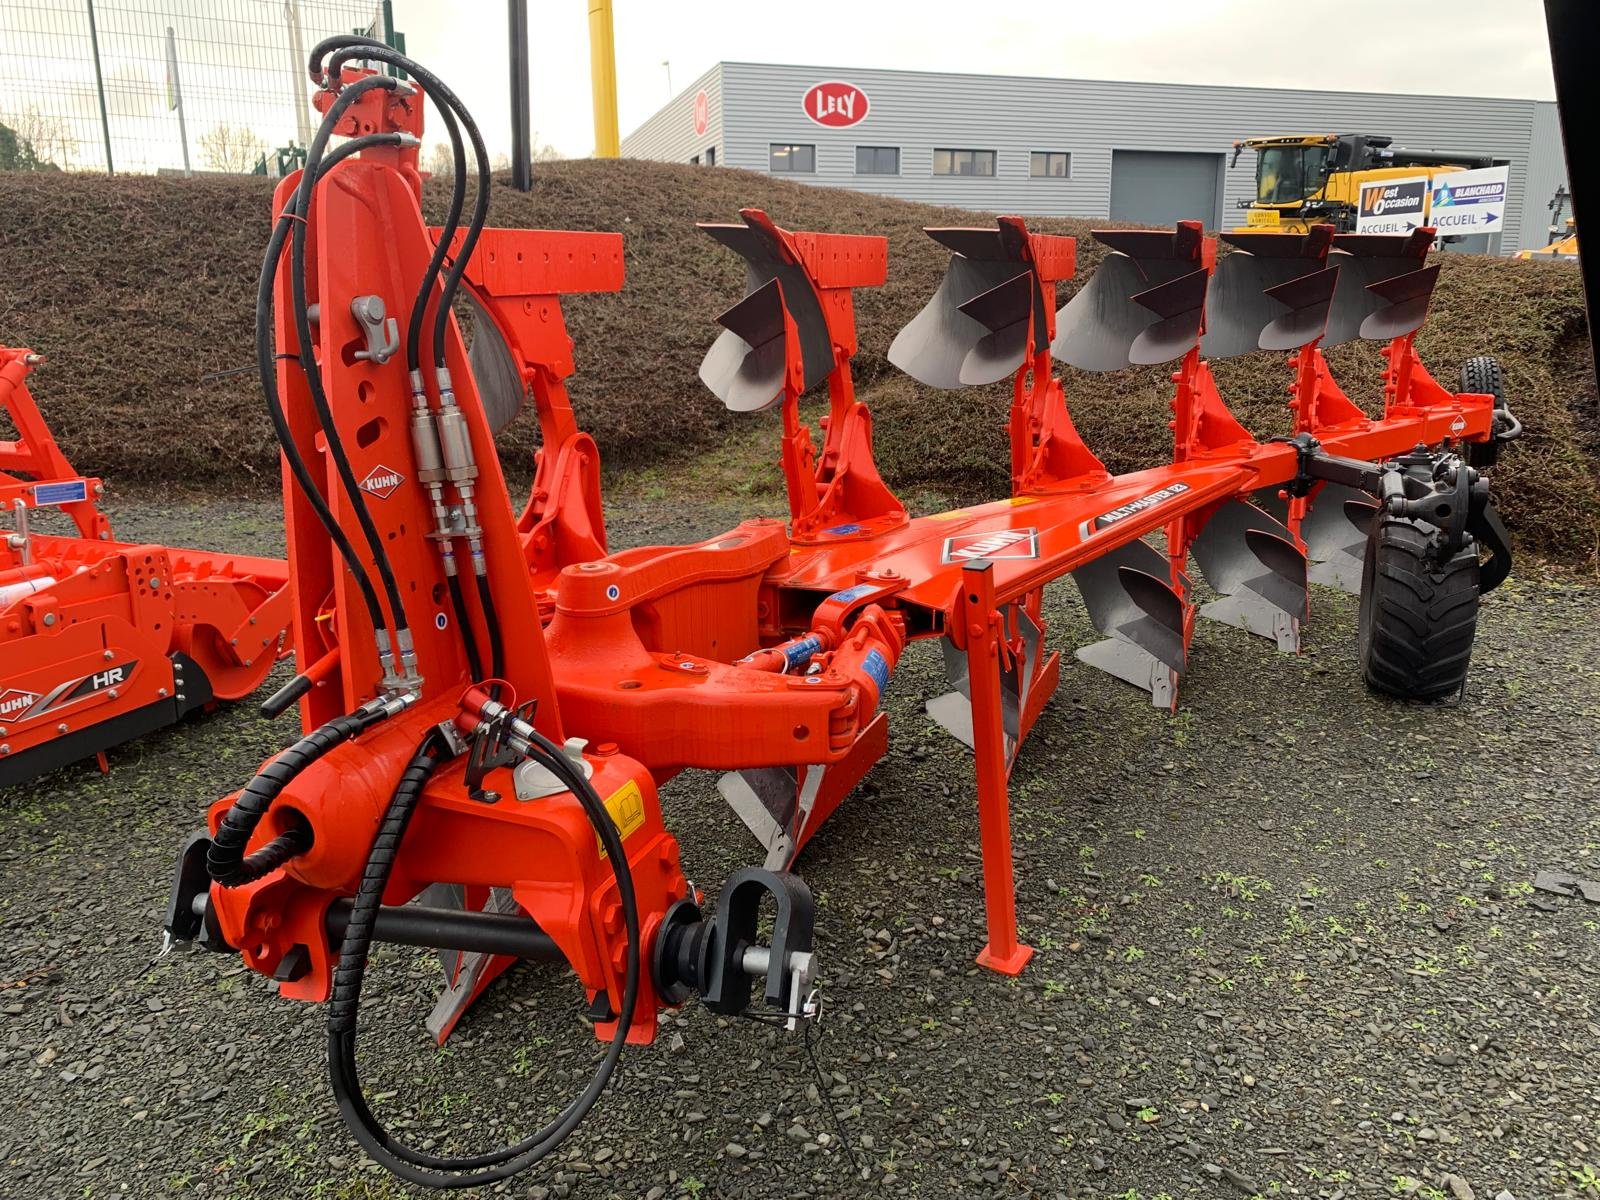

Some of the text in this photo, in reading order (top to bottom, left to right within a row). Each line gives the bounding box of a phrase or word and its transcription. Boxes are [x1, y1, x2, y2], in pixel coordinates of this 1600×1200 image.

[816, 88, 856, 120] LELY
[1364, 186, 1399, 211] West
[1454, 184, 1503, 198] BLANCHARD
[1373, 195, 1420, 216] Occasion
[1361, 223, 1399, 235] ACCUEIL
[1432, 214, 1477, 227] ACCUEIL
[366, 474, 398, 491] KUHN
[950, 531, 1033, 558] KUHN
[93, 667, 124, 690] HR
[0, 694, 33, 714] UHN
